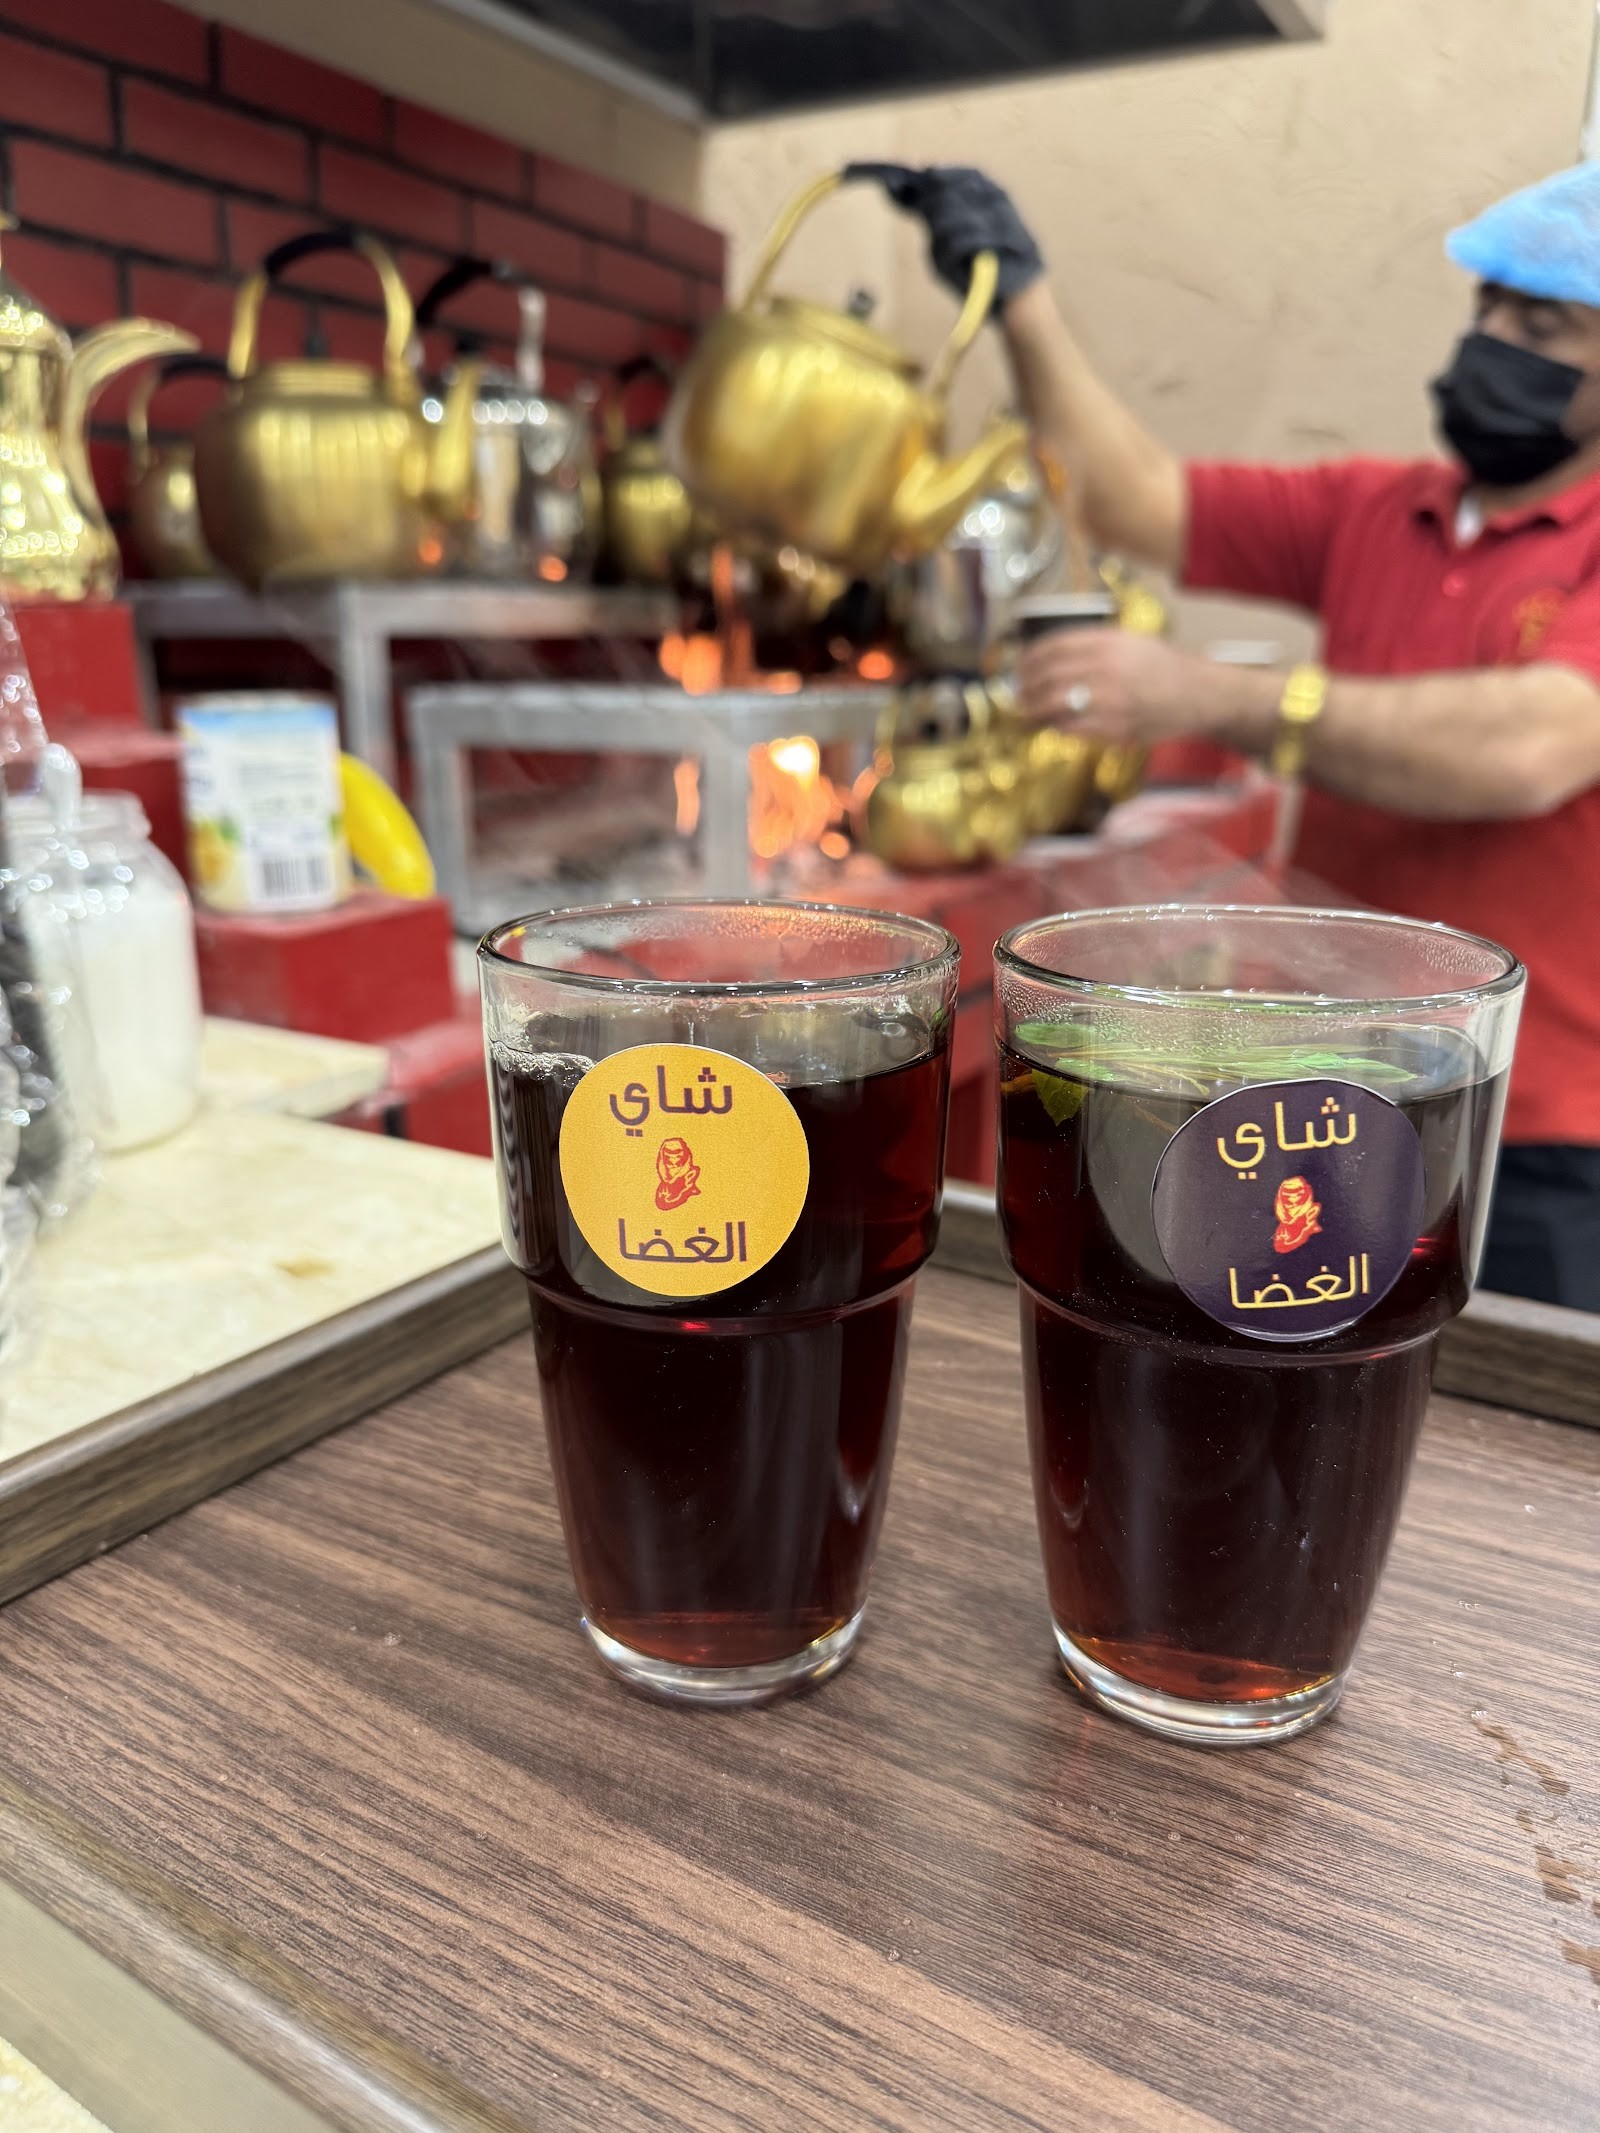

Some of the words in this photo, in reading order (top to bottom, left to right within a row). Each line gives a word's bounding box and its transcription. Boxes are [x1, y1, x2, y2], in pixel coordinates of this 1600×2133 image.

[608, 1064, 734, 1138] شاي
[1216, 1095, 1358, 1181] شاي
[617, 1217, 748, 1264] الغضا
[1228, 1252, 1369, 1311] الغضا
